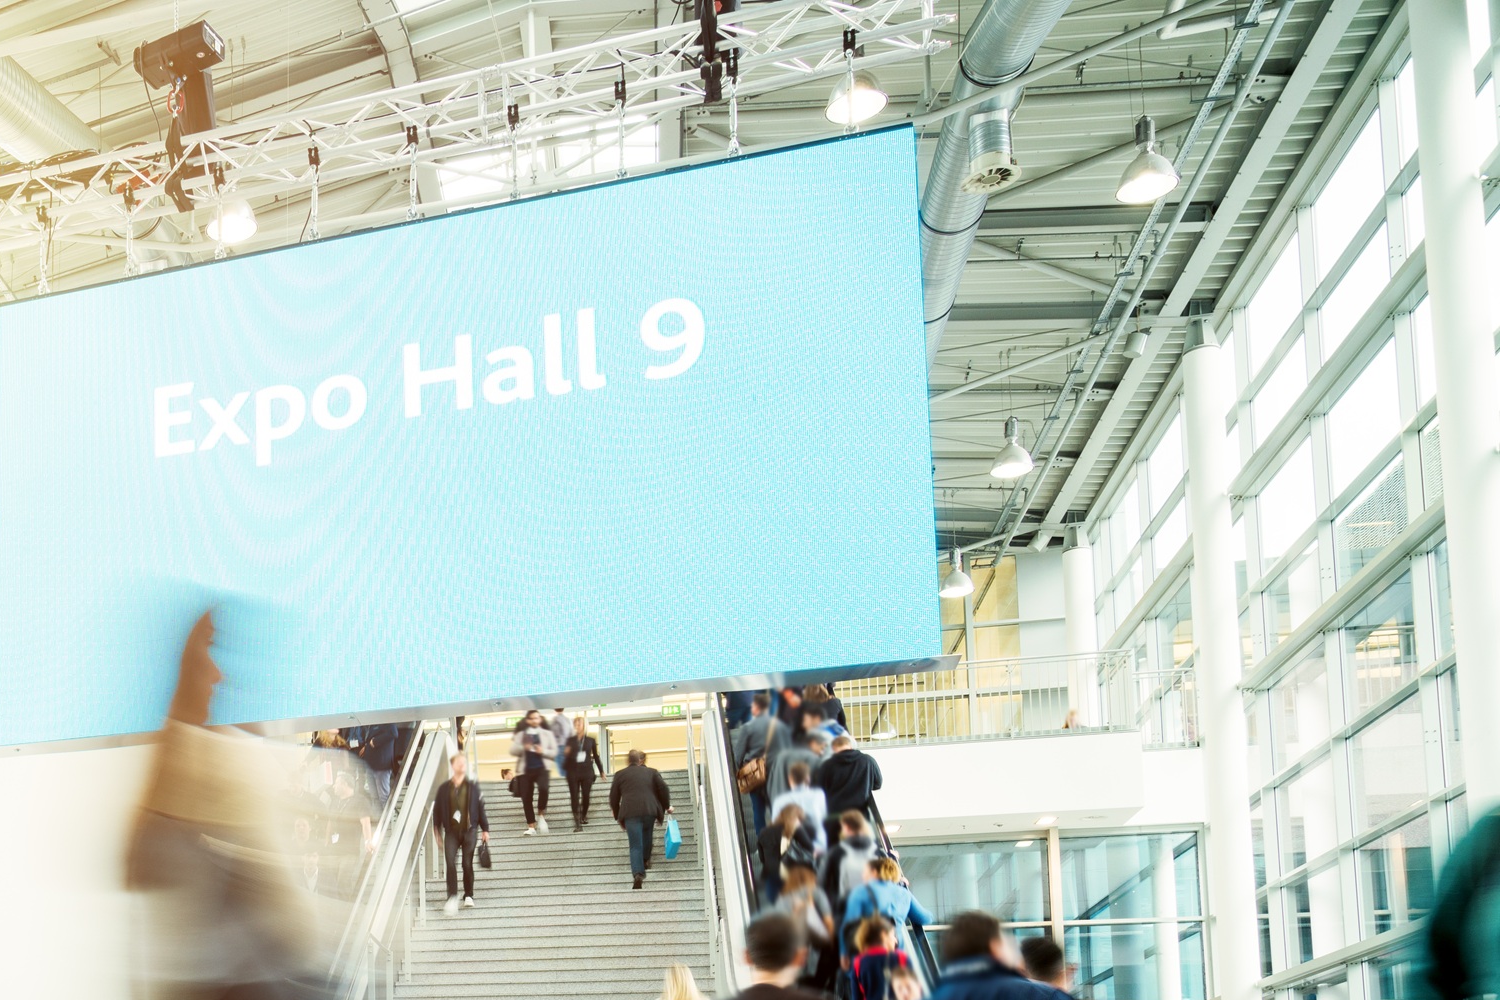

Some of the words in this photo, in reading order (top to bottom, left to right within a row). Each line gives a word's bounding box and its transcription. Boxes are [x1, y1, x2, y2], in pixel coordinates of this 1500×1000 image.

[153, 374, 368, 467] Expo
[403, 307, 607, 418] Hall
[639, 298, 706, 381] 9
